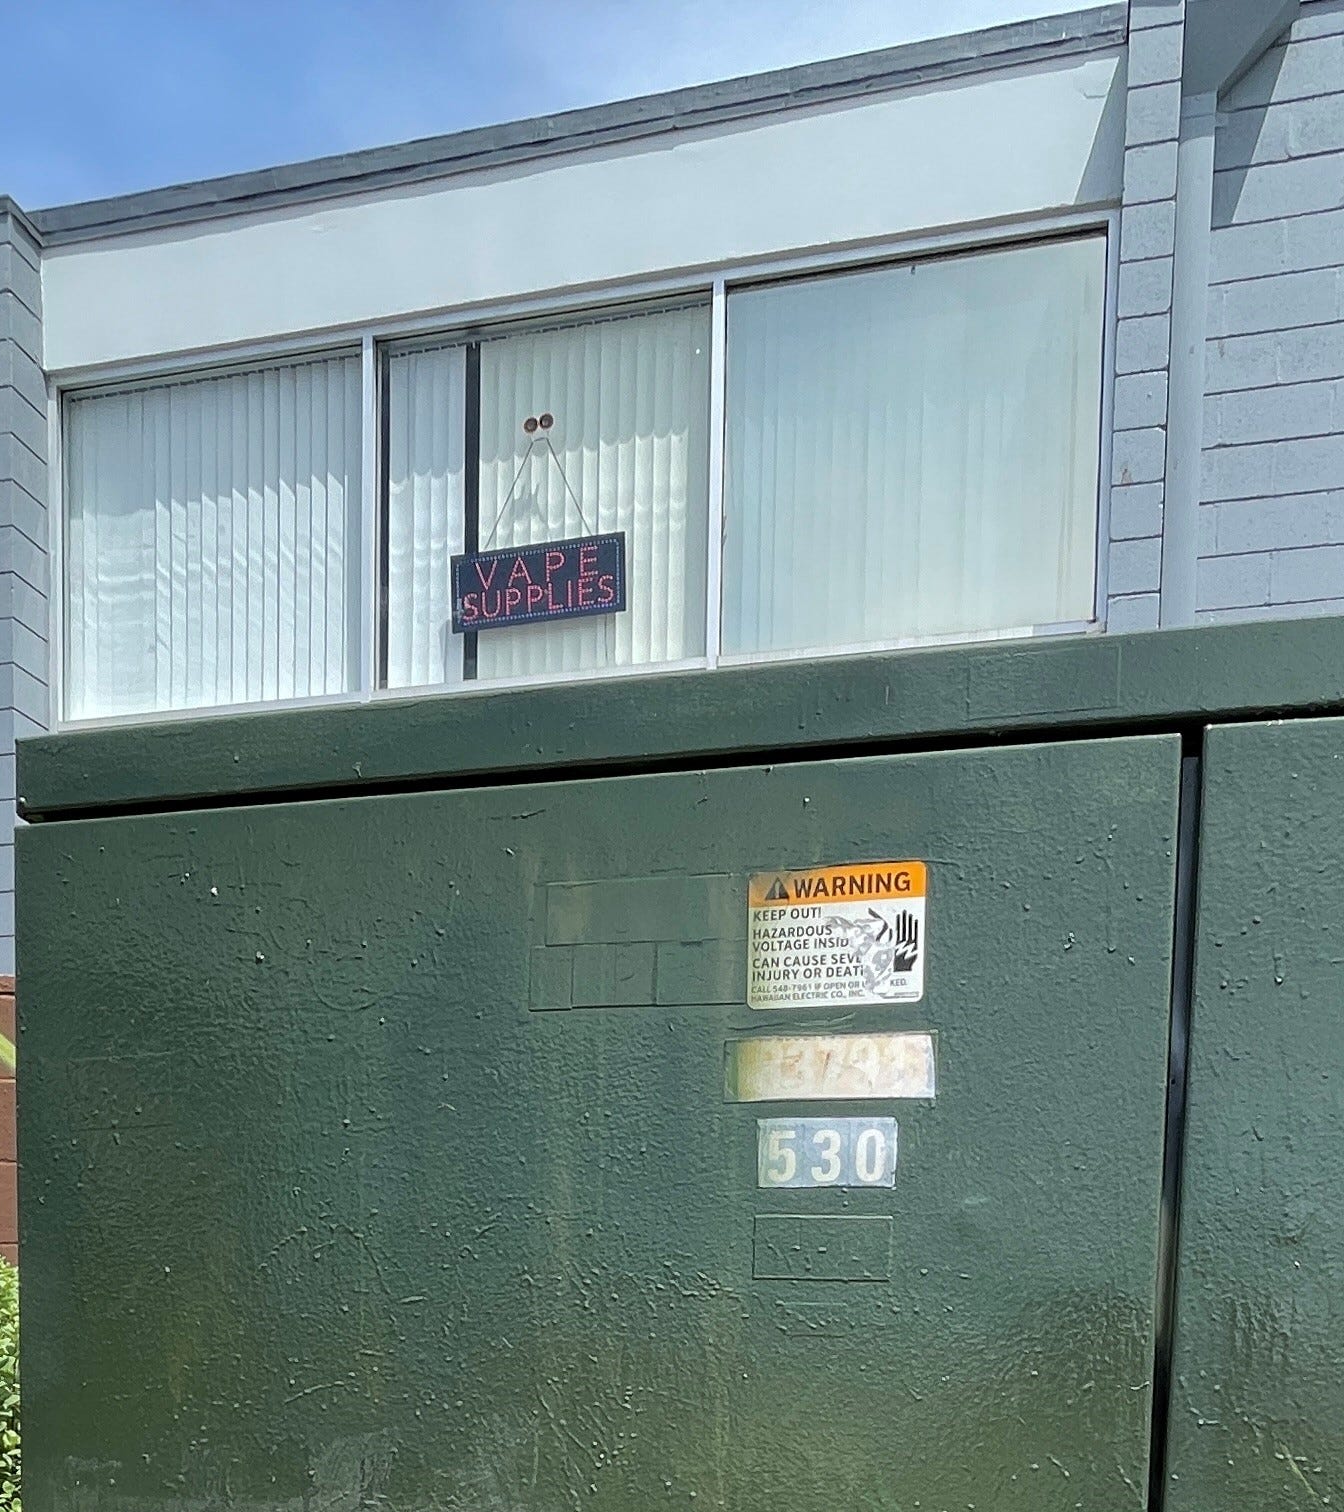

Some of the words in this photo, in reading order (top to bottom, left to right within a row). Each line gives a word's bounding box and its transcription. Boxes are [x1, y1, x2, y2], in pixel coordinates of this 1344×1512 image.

[474, 545, 600, 590] VAPE
[462, 575, 614, 620] SUPPLIES
[794, 871, 911, 899] WARNING
[753, 909, 786, 922] KEEP
[790, 907, 822, 920] OUT!
[753, 925, 833, 940] HAZARDOUS
[753, 939, 810, 953] VOLTAGE
[814, 937, 850, 949] INSID
[753, 957, 780, 969] CAN
[783, 954, 827, 967] CAUSE
[752, 968, 800, 982] INJURY
[803, 967, 822, 979] OR
[751, 985, 772, 993] CALL
[823, 981, 847, 990] OPEN
[848, 980, 860, 989] OR
[792, 991, 828, 1000] ELECTRIC
[767, 1128, 886, 1183] 530
